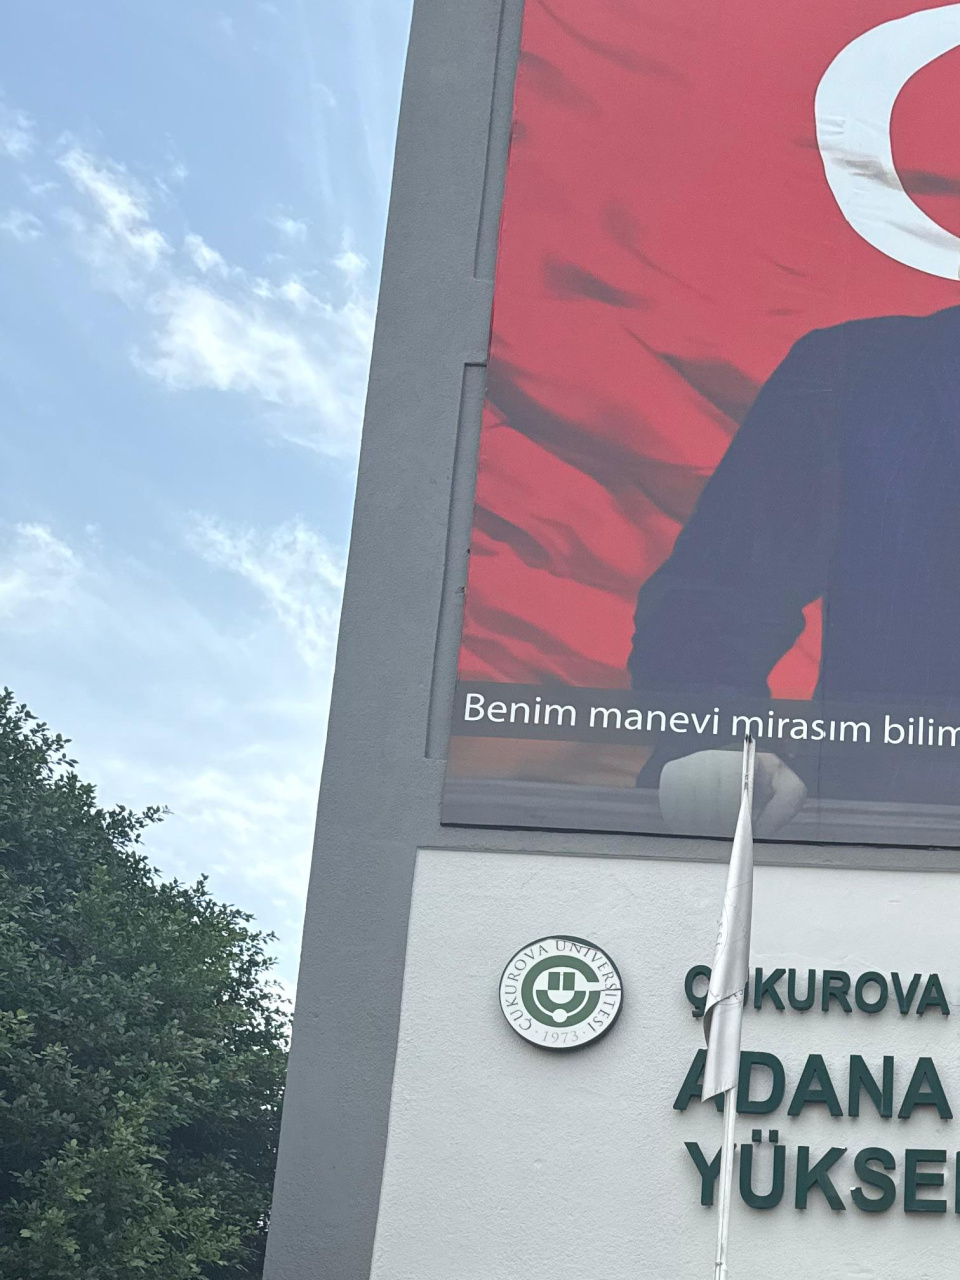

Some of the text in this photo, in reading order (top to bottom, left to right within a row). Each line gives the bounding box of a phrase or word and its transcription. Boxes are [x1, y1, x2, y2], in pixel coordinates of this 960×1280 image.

[463, 692, 577, 728] Benim
[588, 706, 720, 737] manevi
[730, 710, 872, 746] mirasım
[684, 965, 951, 1019] ÇKUROVA
[543, 1030, 579, 1043] 1973
[673, 1048, 954, 1121] ADANA
